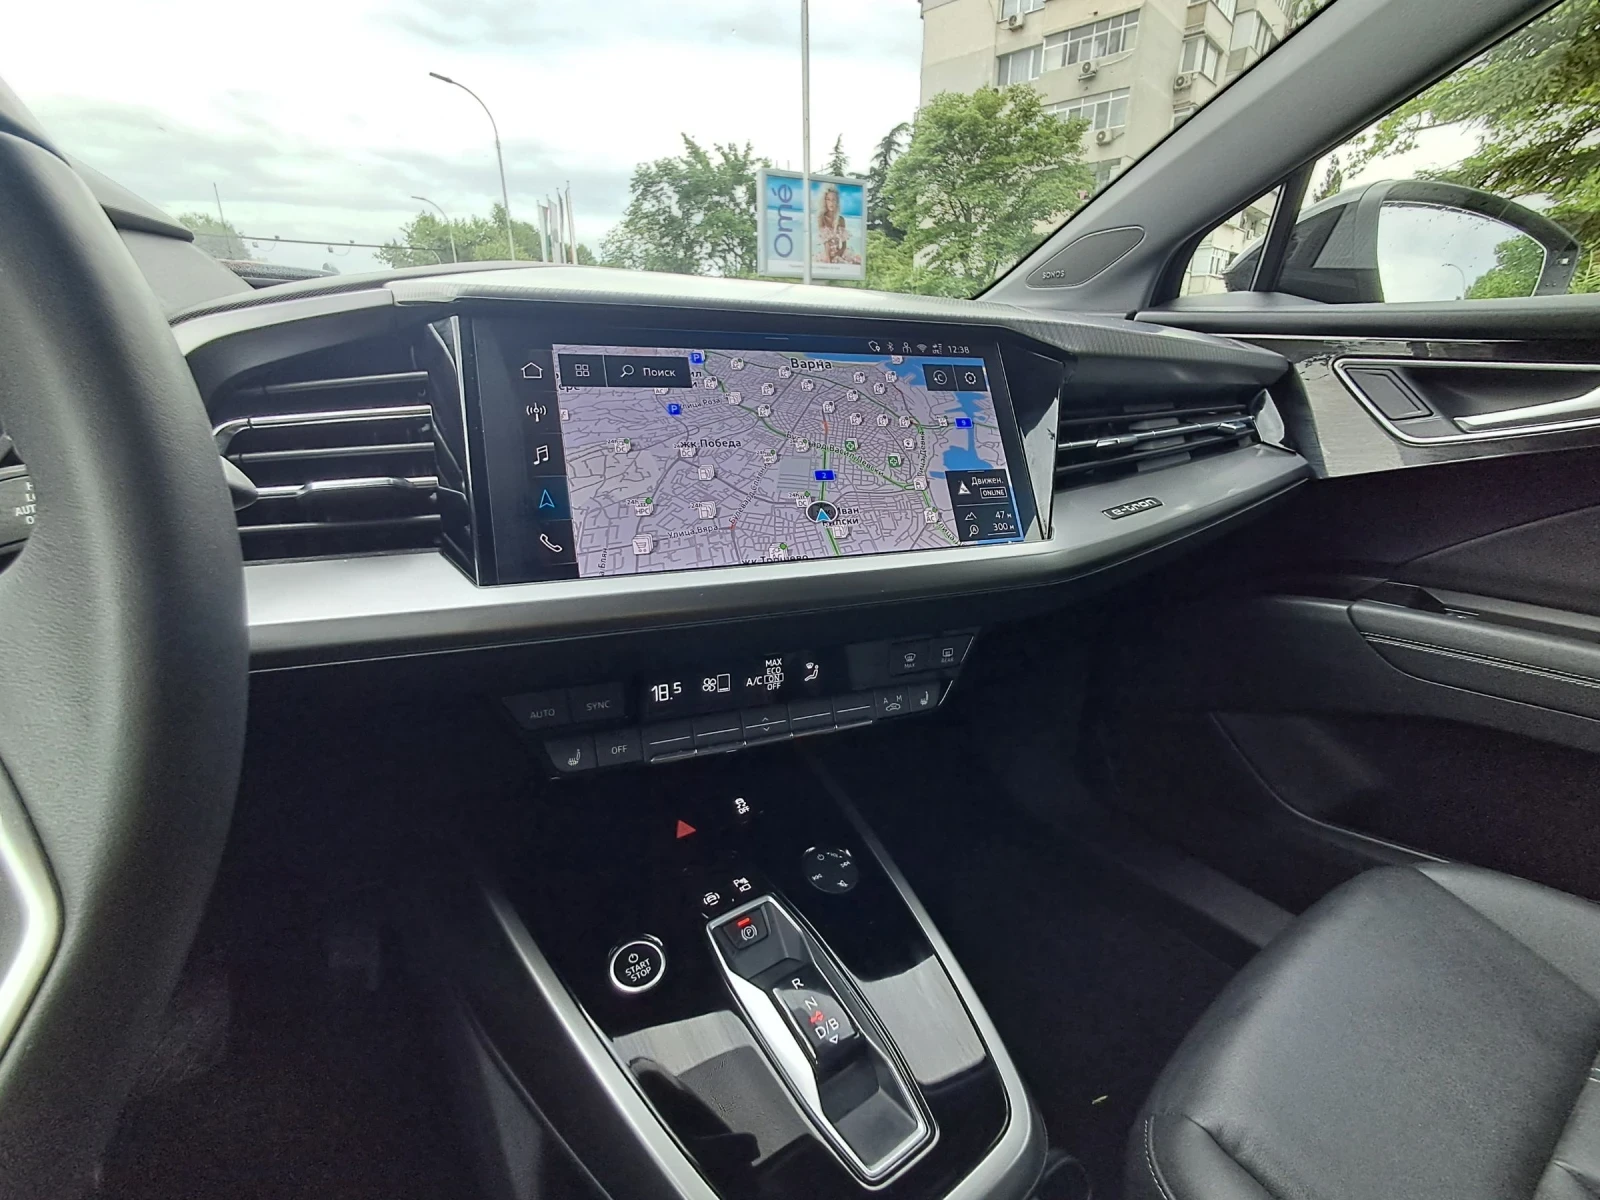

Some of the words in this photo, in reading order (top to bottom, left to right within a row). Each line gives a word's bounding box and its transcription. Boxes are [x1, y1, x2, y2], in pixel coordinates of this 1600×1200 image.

[771, 183, 793, 258] Omé
[1042, 270, 1066, 279] SONOS
[948, 345, 970, 354] 12:38
[790, 358, 832, 372] Варна
[642, 367, 677, 378] Поиск
[700, 439, 742, 449] Победа
[971, 476, 1004, 486] Движен.
[982, 489, 1005, 497] ONLINE
[728, 491, 756, 524] Булевард
[1110, 498, 1157, 515] e-tron
[995, 510, 1005, 518] 47
[667, 529, 695, 539] Улица
[696, 524, 718, 533] Вяра
[993, 522, 1008, 531] 300
[765, 658, 782, 667] MAX
[766, 666, 781, 675] ECO
[746, 675, 763, 687] A/C
[768, 674, 780, 683] ON
[767, 682, 781, 690] OFF
[651, 682, 682, 702] 18.5
[586, 700, 611, 711] SYNC
[530, 708, 556, 719] AUTO
[611, 744, 628, 754] OFF
[625, 957, 651, 977] START
[630, 966, 652, 982] STOP
[791, 977, 804, 990] R
[804, 996, 818, 1010] N
[815, 1018, 840, 1040] D/B
